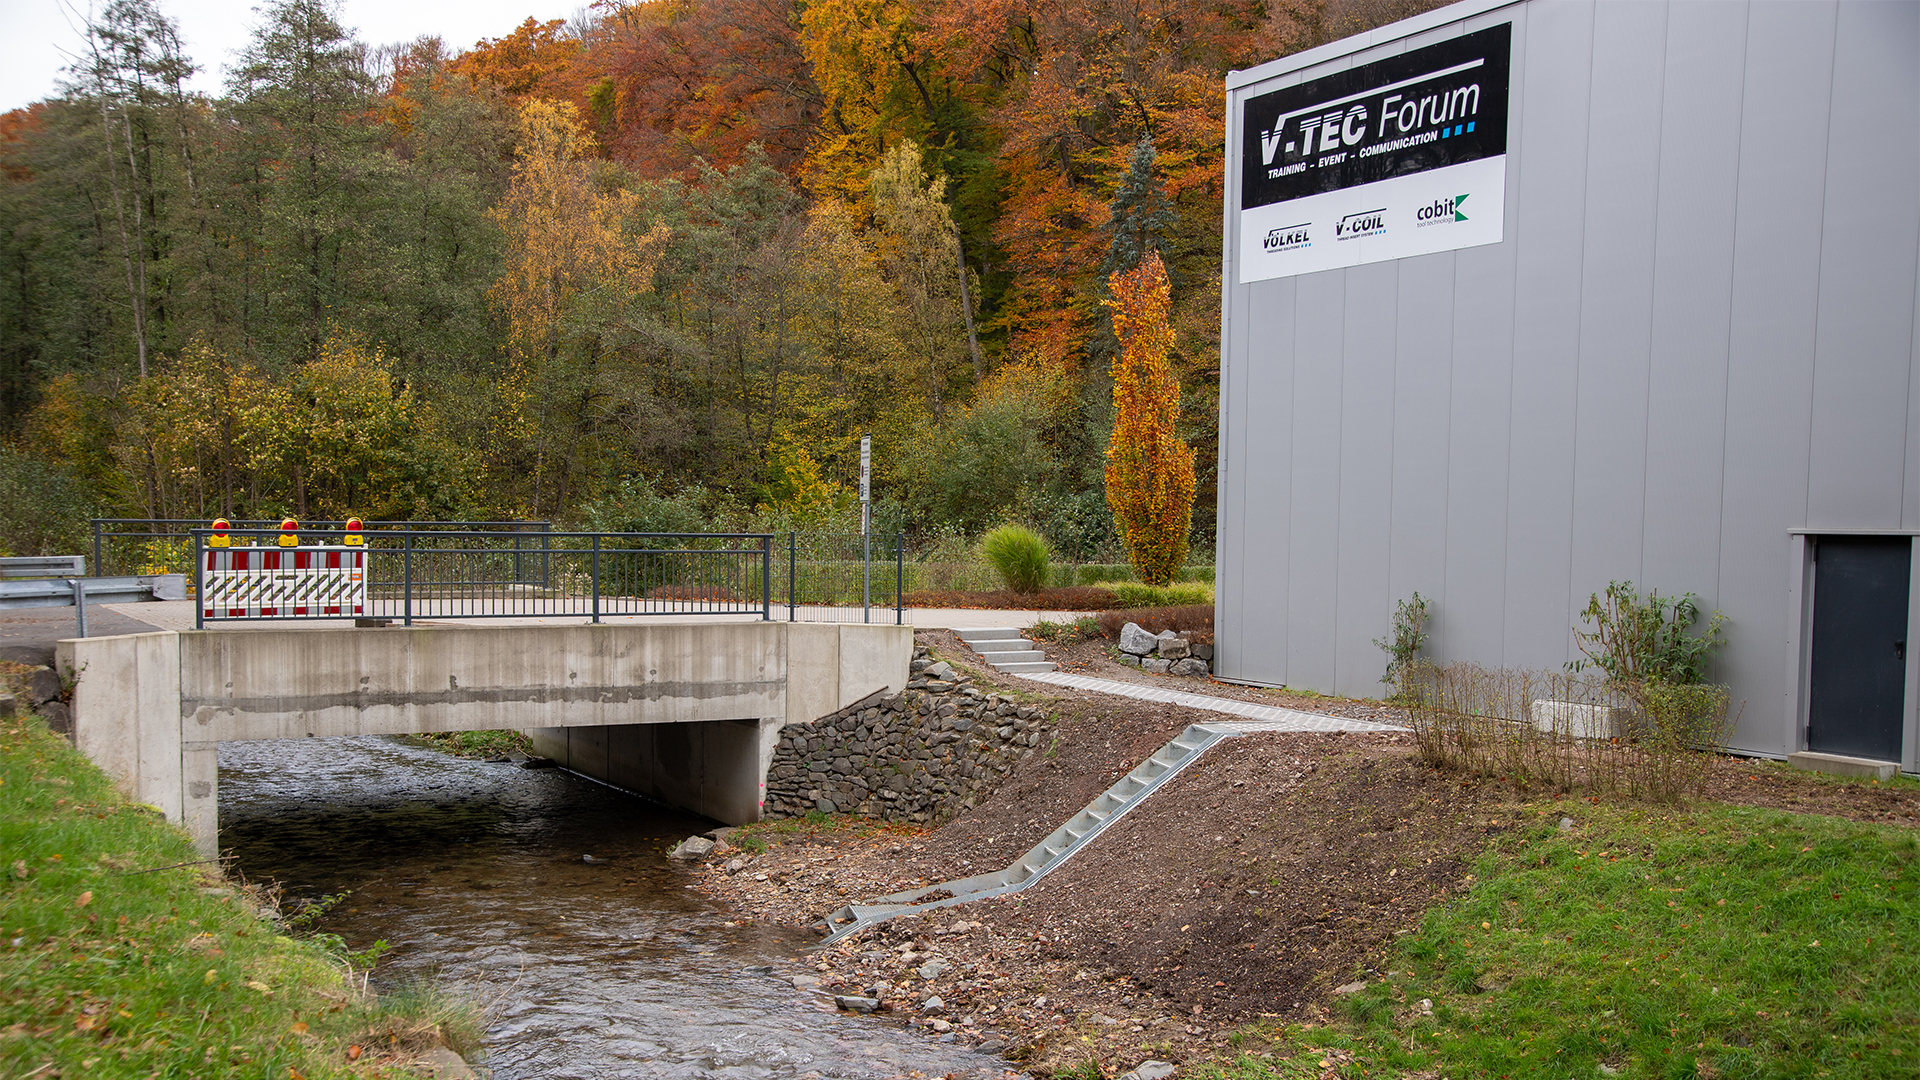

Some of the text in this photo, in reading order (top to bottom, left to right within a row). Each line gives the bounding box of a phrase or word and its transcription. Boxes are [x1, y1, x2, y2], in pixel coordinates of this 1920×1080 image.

[1261, 83, 1480, 166] V-TEC Forum
[1268, 161, 1307, 180] TRAINING
[1318, 152, 1347, 168] EVENT
[1359, 130, 1438, 158] COMMUNICATION
[1417, 198, 1454, 221] cobit
[1336, 215, 1384, 236] V-COIL
[1427, 217, 1454, 227] technology
[1263, 230, 1310, 249] VÖLKEL
